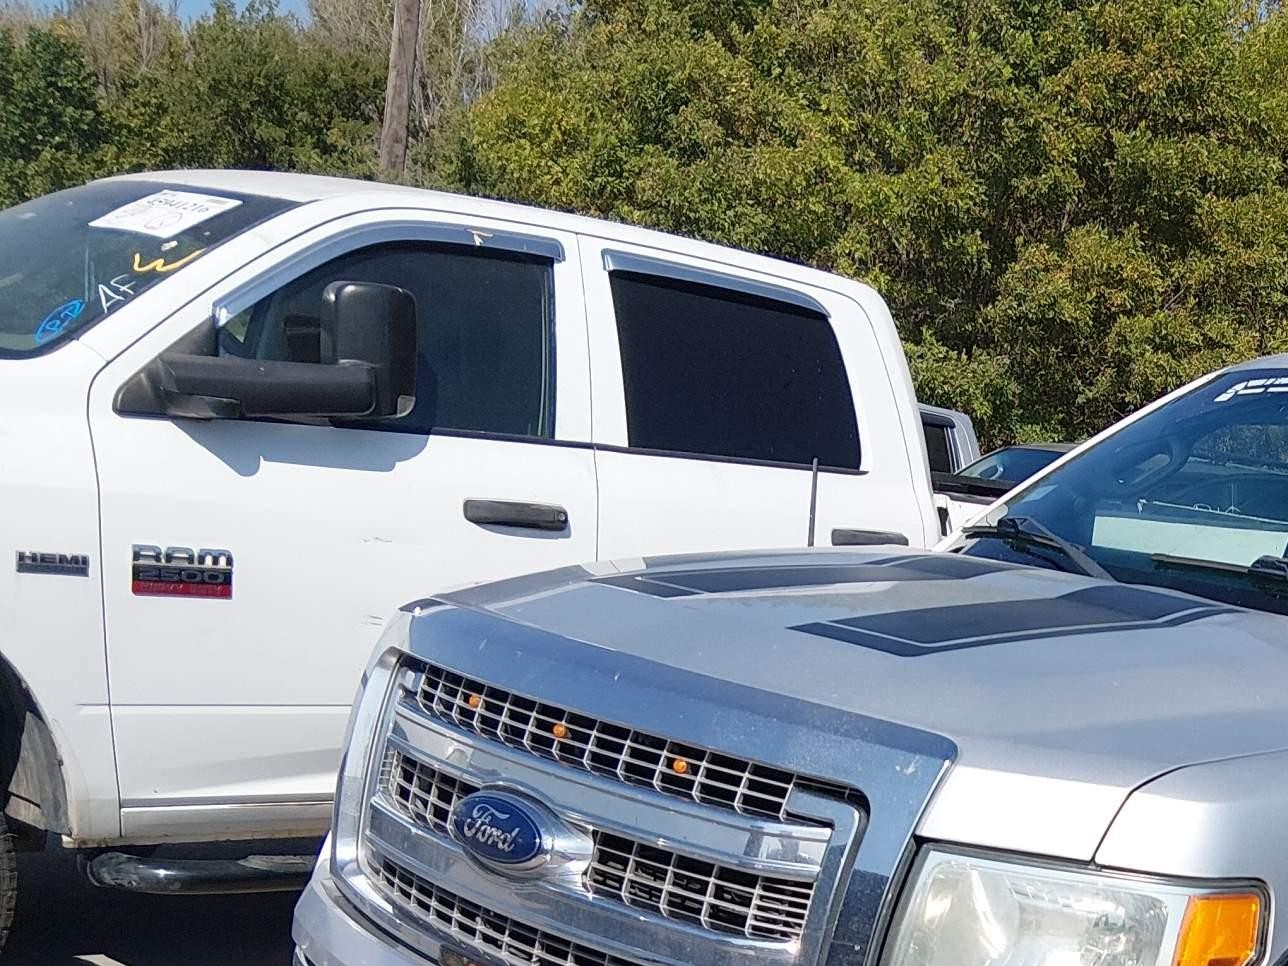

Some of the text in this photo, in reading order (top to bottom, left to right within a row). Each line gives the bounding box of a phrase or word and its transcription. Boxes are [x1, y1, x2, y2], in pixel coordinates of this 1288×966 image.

[18, 551, 89, 566] HEMI
[132, 544, 234, 568] RAM
[138, 567, 224, 583] 2500
[464, 803, 521, 852] Ford
